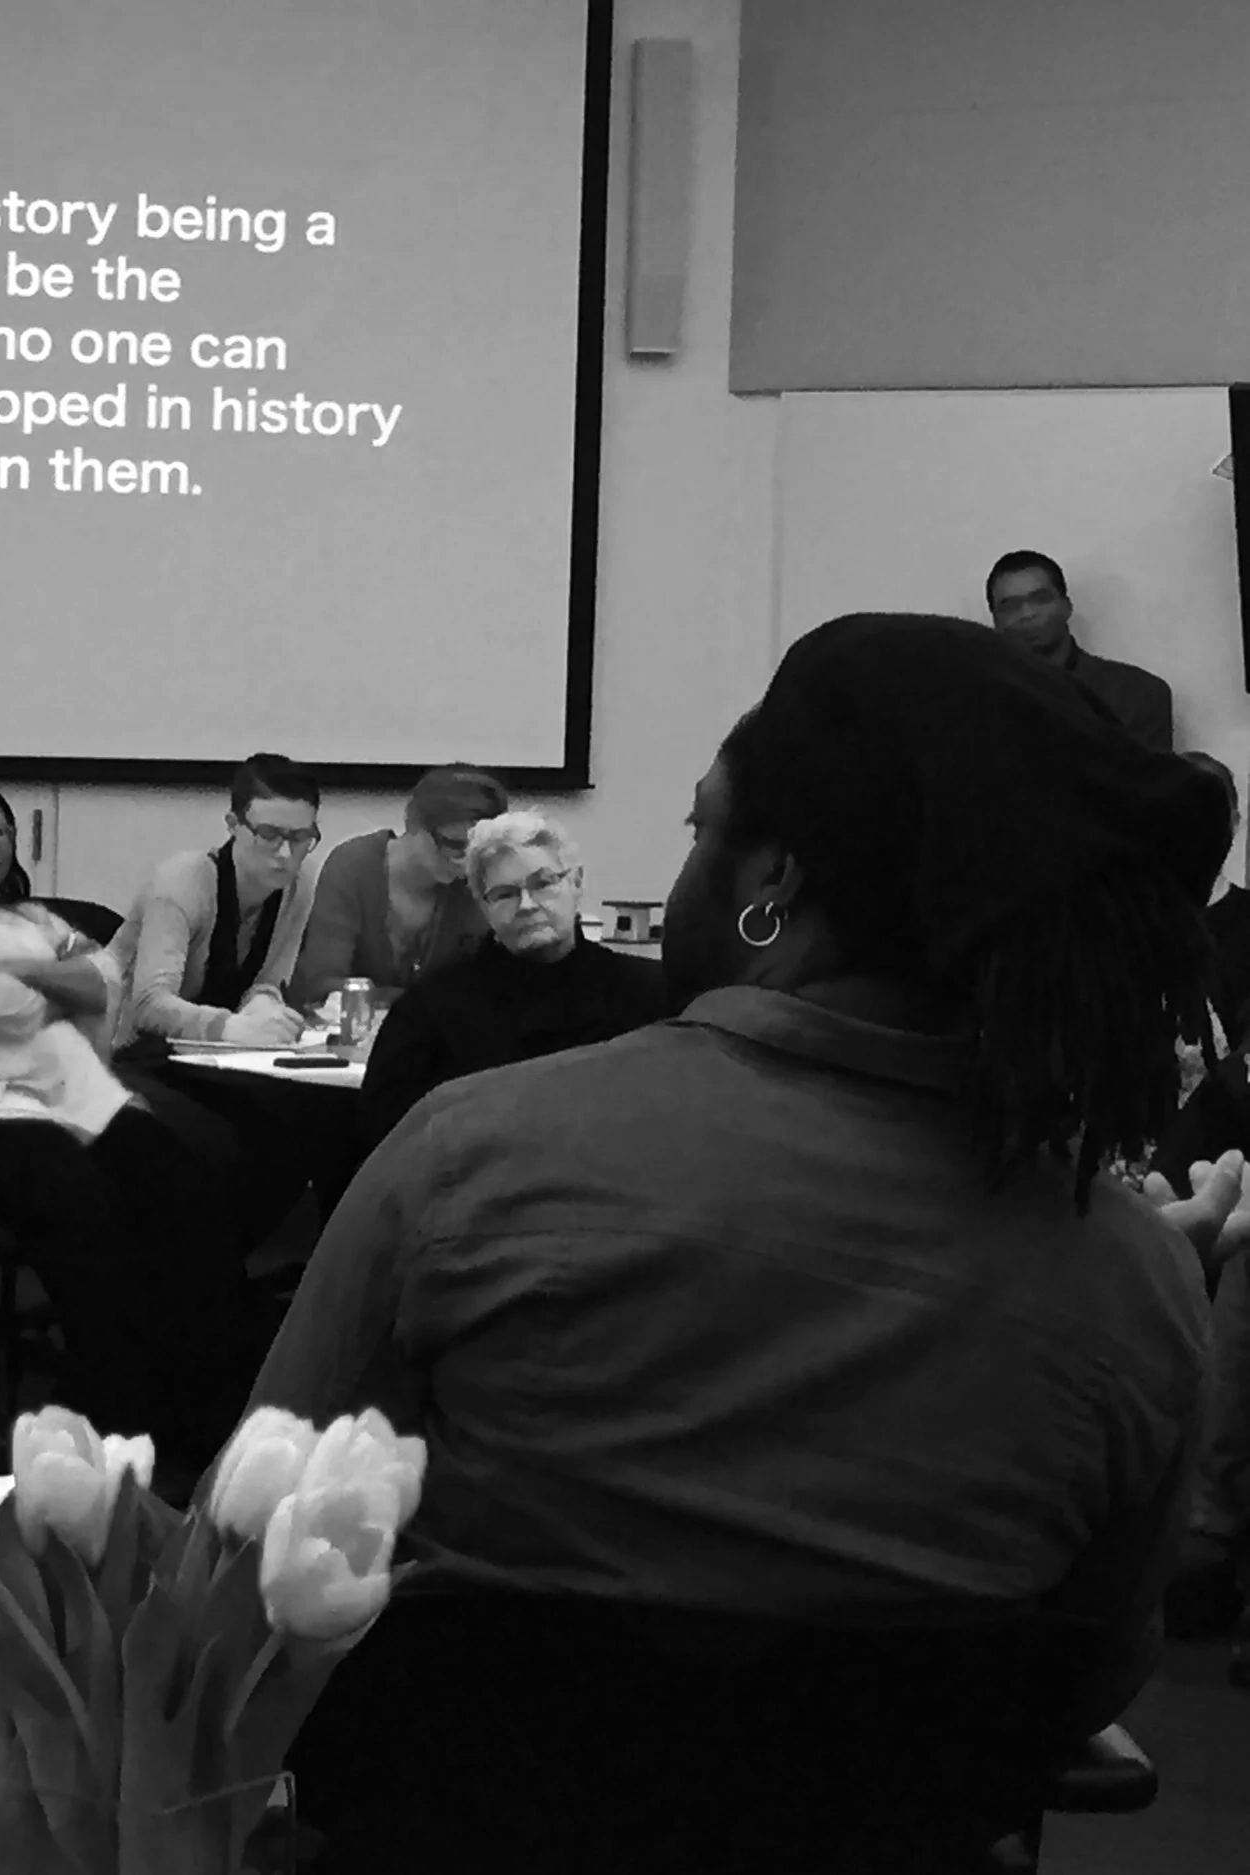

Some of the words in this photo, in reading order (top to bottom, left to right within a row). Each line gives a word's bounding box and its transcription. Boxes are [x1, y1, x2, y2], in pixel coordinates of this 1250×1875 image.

[137, 192, 287, 253] being
[305, 211, 336, 246] a
[6, 250, 74, 299] be
[91, 255, 181, 303] the
[70, 329, 172, 368] one
[190, 333, 287, 372] can
[146, 383, 191, 430] in
[212, 386, 403, 447] history
[48, 446, 203, 496] them.
